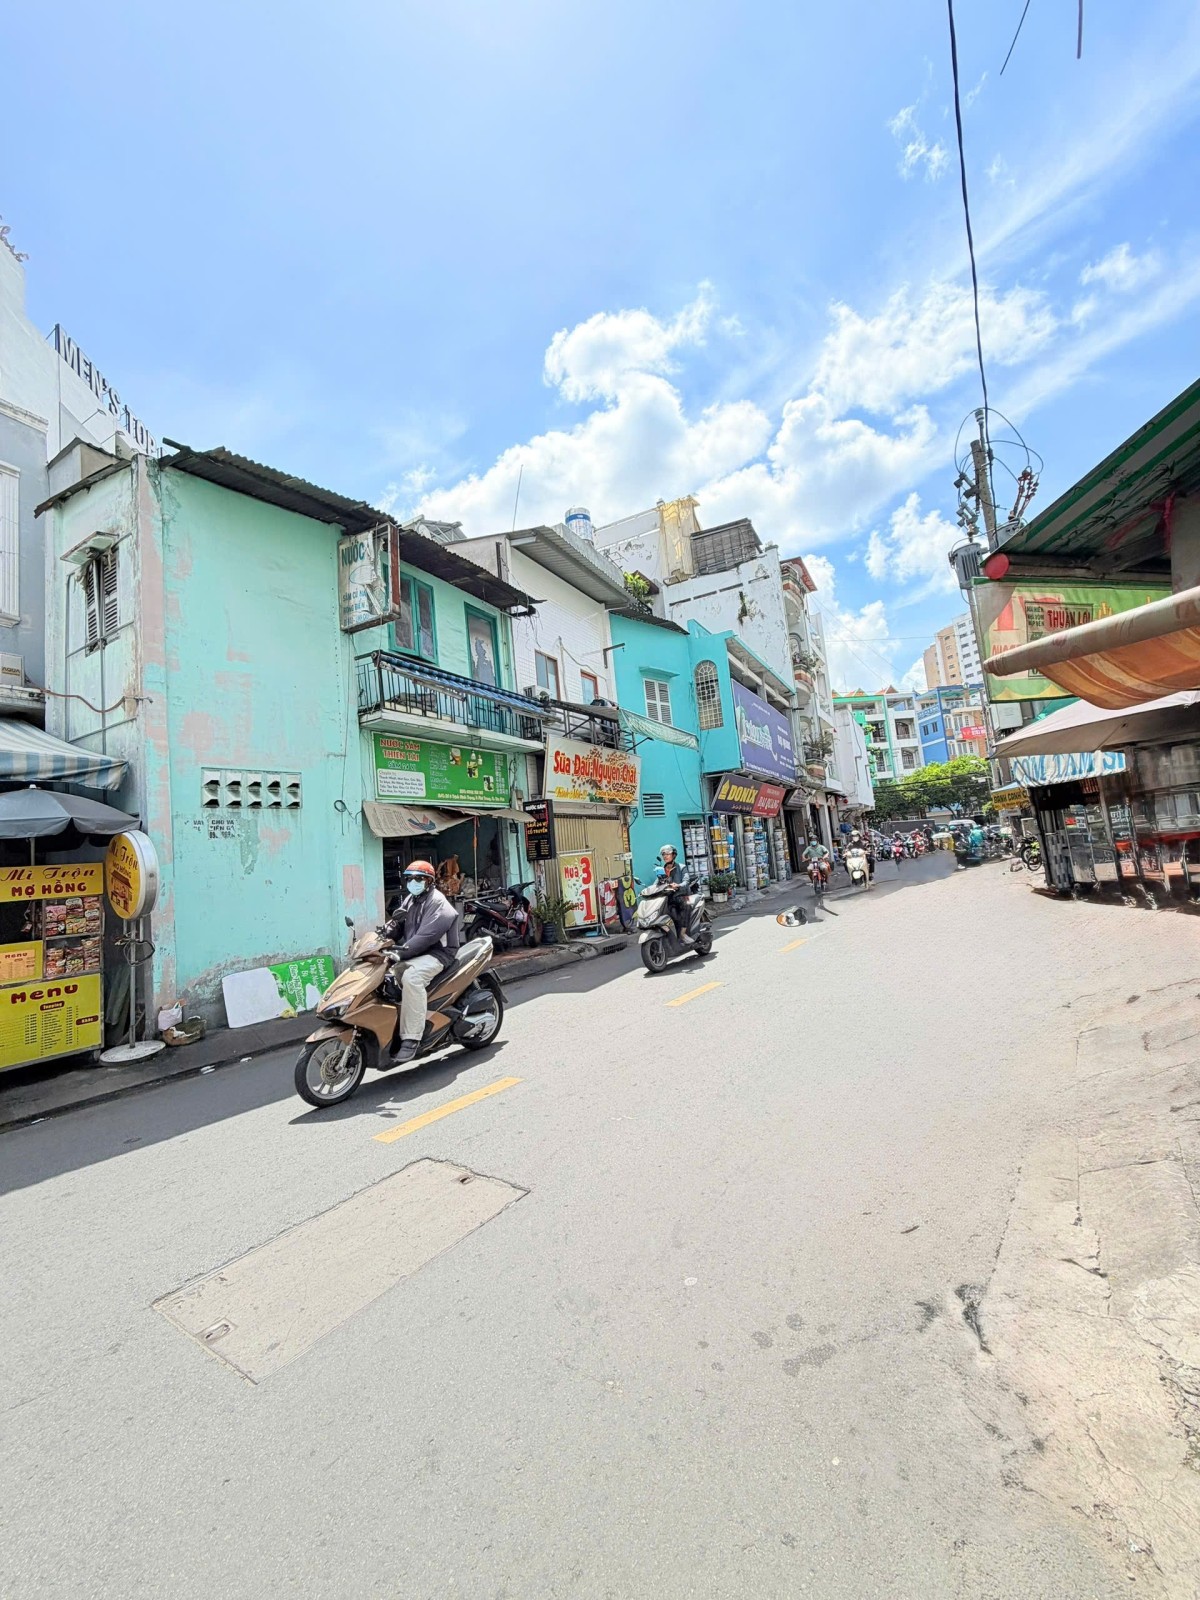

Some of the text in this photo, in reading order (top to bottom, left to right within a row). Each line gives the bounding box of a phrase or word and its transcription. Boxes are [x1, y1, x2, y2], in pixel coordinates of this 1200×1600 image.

[43, 867, 95, 880] Trộn
[580, 857, 592, 885] 3
[12, 880, 87, 898] MỢ HỒNG
[581, 888, 596, 921] 1
